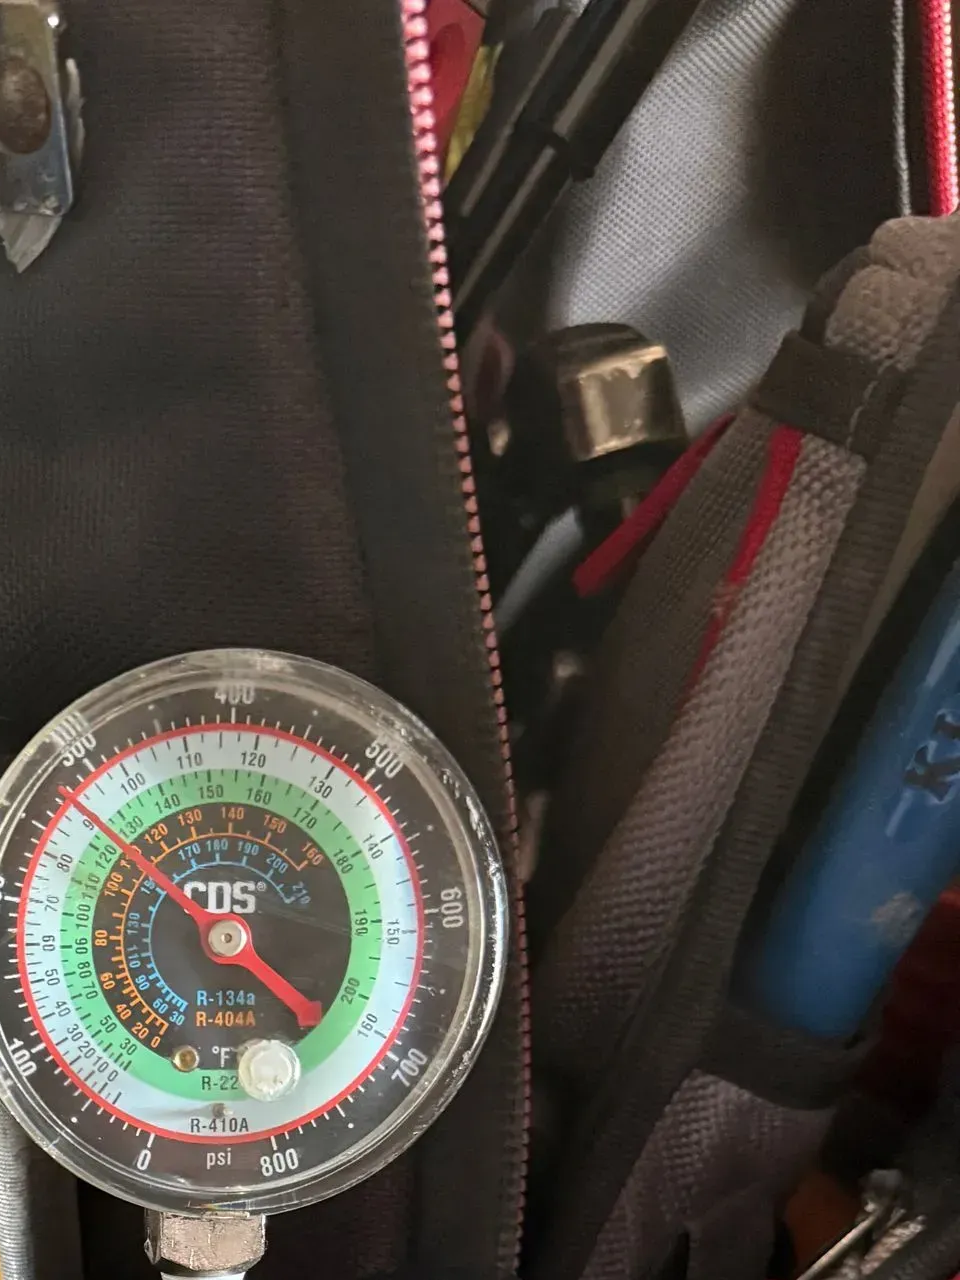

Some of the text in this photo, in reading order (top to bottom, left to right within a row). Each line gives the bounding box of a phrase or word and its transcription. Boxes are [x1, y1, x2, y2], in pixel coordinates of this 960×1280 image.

[214, 682, 255, 705] 400
[177, 752, 203, 770] 110
[241, 753, 266, 769] 120
[365, 738, 404, 778] 500
[121, 773, 146, 795] 100
[198, 784, 224, 799] 150
[310, 776, 333, 799] 130
[154, 793, 181, 814] 140
[246, 788, 272, 805] 160
[177, 809, 202, 827] 130
[221, 806, 245, 820] 140
[292, 807, 317, 830] 170
[119, 816, 144, 840] 130
[263, 814, 287, 834] 150
[143, 823, 168, 846] 120
[178, 842, 201, 861] 170
[206, 838, 228, 852] 180
[238, 841, 260, 856] 190
[301, 842, 324, 866] 160
[363, 833, 384, 860] 140
[56, 853, 73, 873] 80
[95, 844, 117, 870] 120
[266, 853, 288, 874] 200
[333, 848, 354, 874] 180
[82, 872, 100, 900] 110
[104, 872, 124, 897] 100
[44, 895, 59, 912] 70
[441, 886, 464, 928] 600
[76, 903, 91, 928] 100
[127, 912, 140, 935] 130
[354, 909, 369, 936] 190
[95, 929, 108, 947] 80
[387, 918, 400, 945] 150
[42, 935, 56, 952] 60
[128, 945, 141, 969] 110
[45, 968, 60, 986] 50
[78, 961, 92, 979] 80
[100, 971, 116, 990] 60
[135, 975, 150, 991] 90
[83, 983, 98, 1000] 70
[196, 990, 255, 1006] R-134a
[341, 977, 360, 1005] 200
[56, 1001, 71, 1018] 40
[115, 1003, 132, 1020] 40
[153, 998, 169, 1014] 60
[100, 1015, 117, 1033] 50
[169, 1011, 185, 1026] 30
[195, 1012, 256, 1027] R-404A
[357, 1013, 378, 1038] 160
[67, 1024, 84, 1042] 30
[131, 1022, 149, 1039] 20
[78, 1041, 95, 1058] 20
[120, 1037, 138, 1055] 30
[150, 1037, 161, 1049] 0
[8, 1038, 38, 1077] 100
[91, 1056, 109, 1073] 10
[107, 1070, 119, 1082] 0
[391, 1048, 428, 1087] 700
[202, 1076, 239, 1091] R-22
[191, 1118, 249, 1133] R-410A
[136, 1150, 151, 1171] 0
[206, 1148, 232, 1170] psi
[260, 1148, 299, 1177] 800
